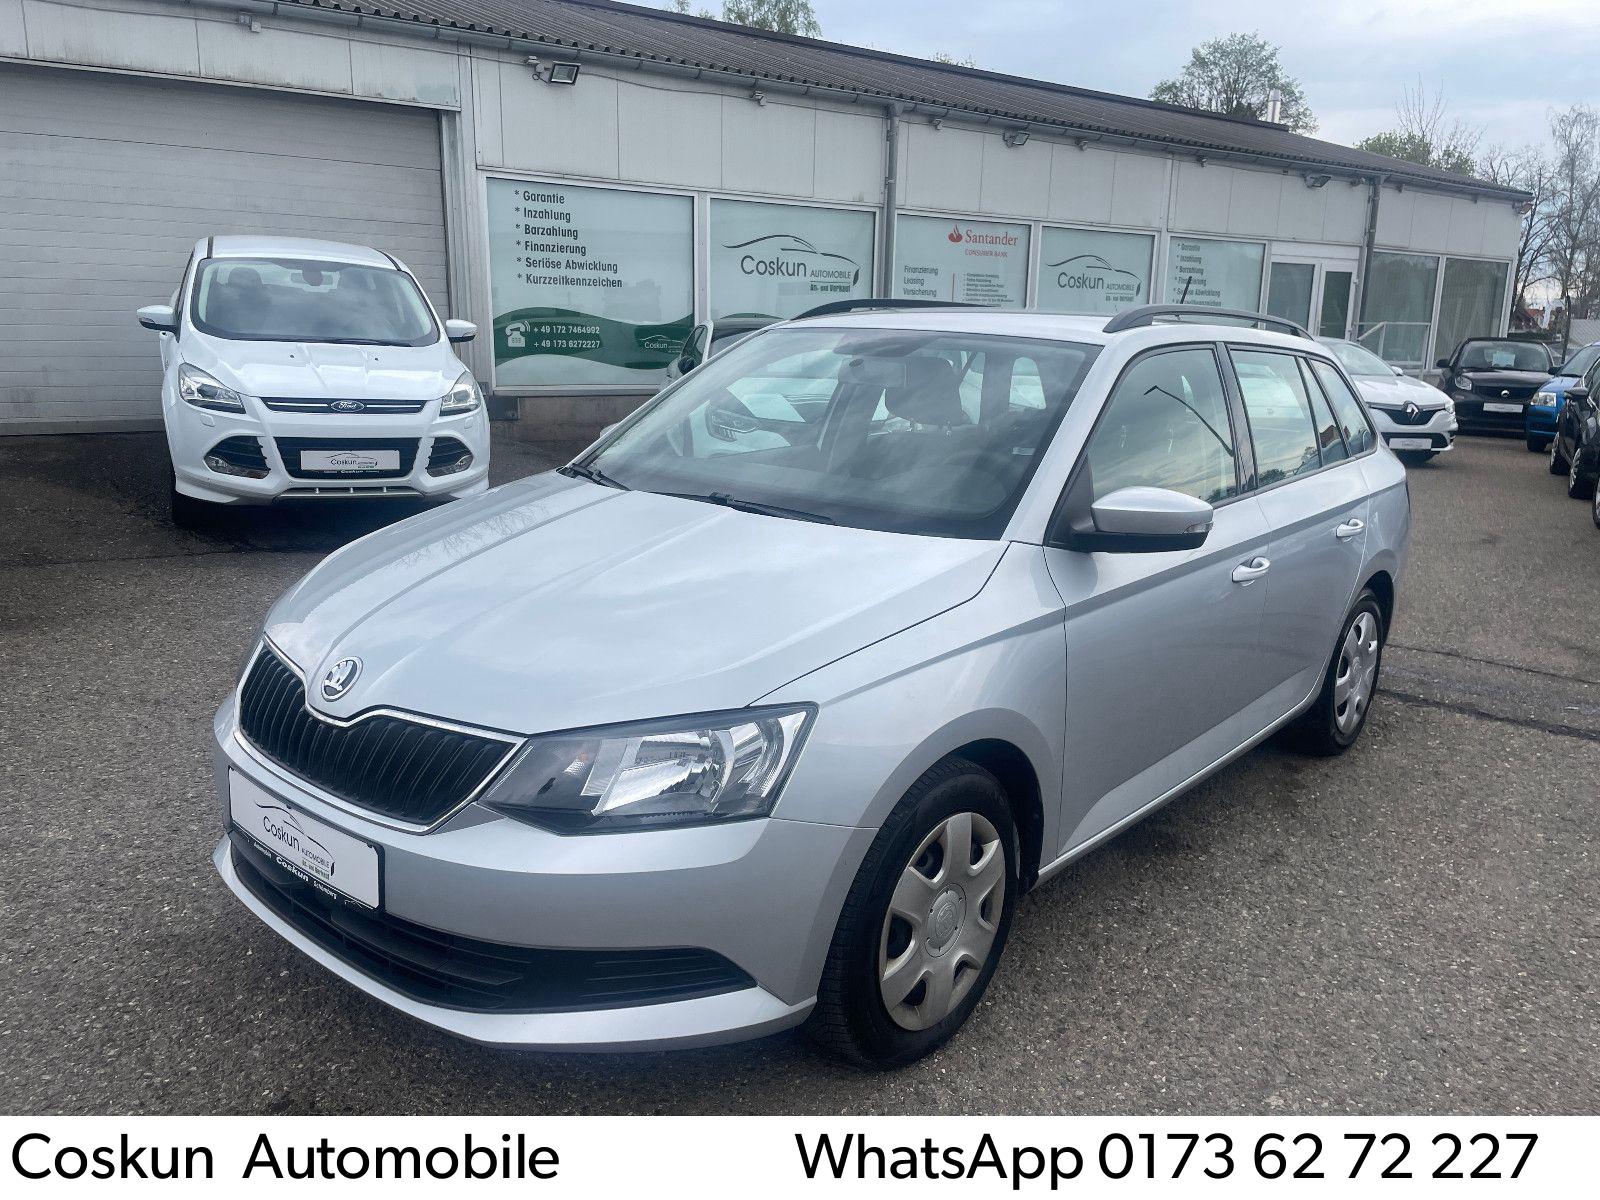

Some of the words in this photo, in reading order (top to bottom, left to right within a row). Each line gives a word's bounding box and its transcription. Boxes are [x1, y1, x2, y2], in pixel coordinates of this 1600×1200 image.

[523, 190, 565, 204] Garantie
[523, 207, 571, 223] Inzahlung
[524, 224, 578, 240] Barzahlung
[965, 229, 1018, 246] Santander
[525, 241, 587, 256] Finanzierung
[525, 257, 562, 270] Seriöse
[565, 259, 618, 274] Abwicklung
[741, 255, 807, 277] Coskun
[809, 269, 851, 279] AUTOMOBILE
[904, 265, 939, 276] Finanzierung
[526, 274, 623, 288] Kurzzeitkennzeichen
[903, 277, 925, 286] Leasing
[1057, 272, 1104, 290] Coskun
[1106, 283, 1135, 291] AUTOMOBILE
[903, 288, 937, 297] Versicherung
[541, 325, 551, 334] 49
[552, 325, 567, 334] 172
[568, 325, 600, 334] 7464992
[541, 340, 551, 348] 49
[553, 340, 567, 348] 173
[568, 340, 600, 349] 6272227
[644, 341, 668, 349] Coskun
[338, 401, 357, 410] Ford
[263, 815, 300, 852] Coskun
[301, 847, 330, 869] AUTOMOBILE
[276, 856, 309, 882] Coskun
